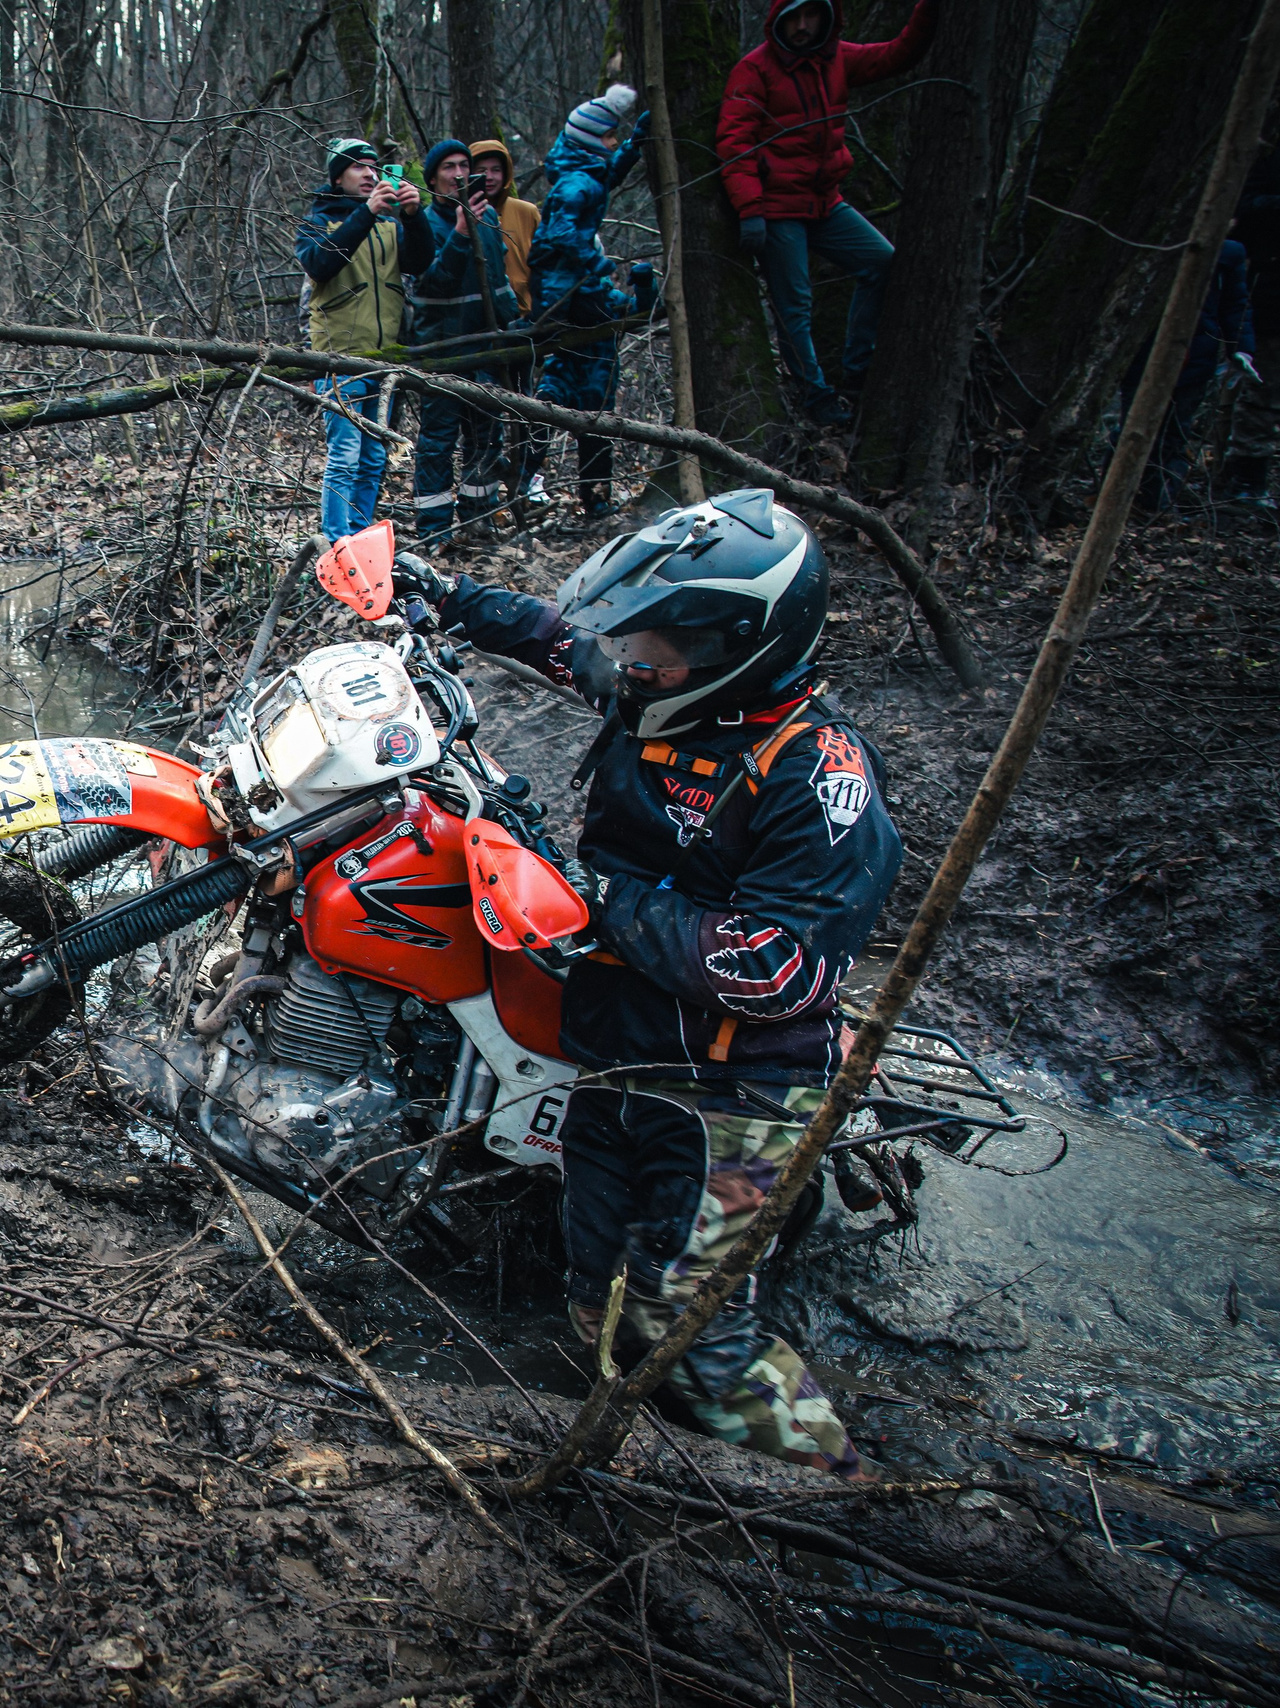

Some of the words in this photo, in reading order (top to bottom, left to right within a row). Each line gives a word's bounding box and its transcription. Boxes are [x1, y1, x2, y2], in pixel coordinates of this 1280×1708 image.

[341, 673, 387, 707] 181
[388, 732, 408, 756] 181
[830, 781, 863, 813] 111
[480, 897, 503, 934] CYCRA
